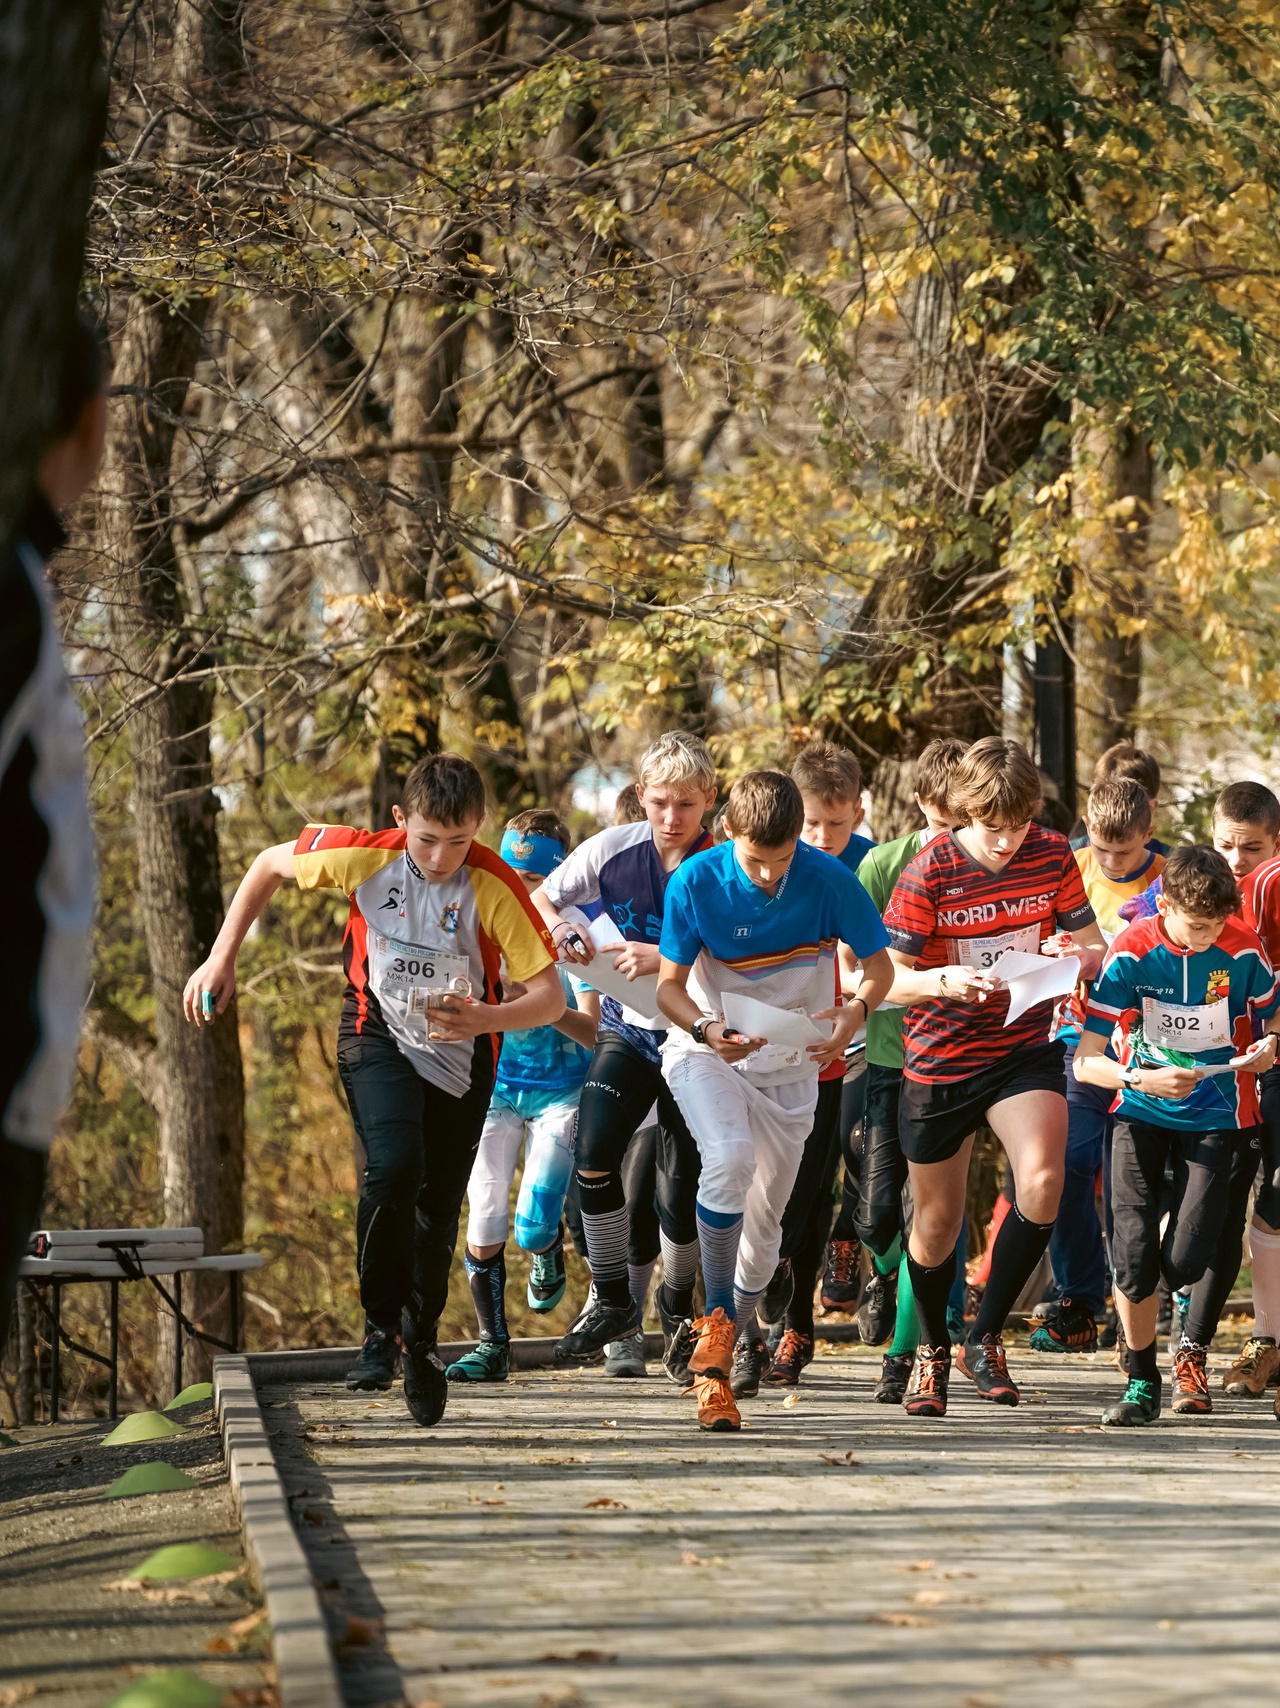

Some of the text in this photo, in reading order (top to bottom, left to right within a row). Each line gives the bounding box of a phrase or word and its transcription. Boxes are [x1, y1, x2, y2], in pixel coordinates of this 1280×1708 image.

[937, 904, 997, 927] NORD
[386, 972, 414, 984] МЖ14
[393, 958, 450, 983] 306 1
[1157, 1025, 1182, 1036] МЖ14
[1161, 1014, 1214, 1031] 302 1
